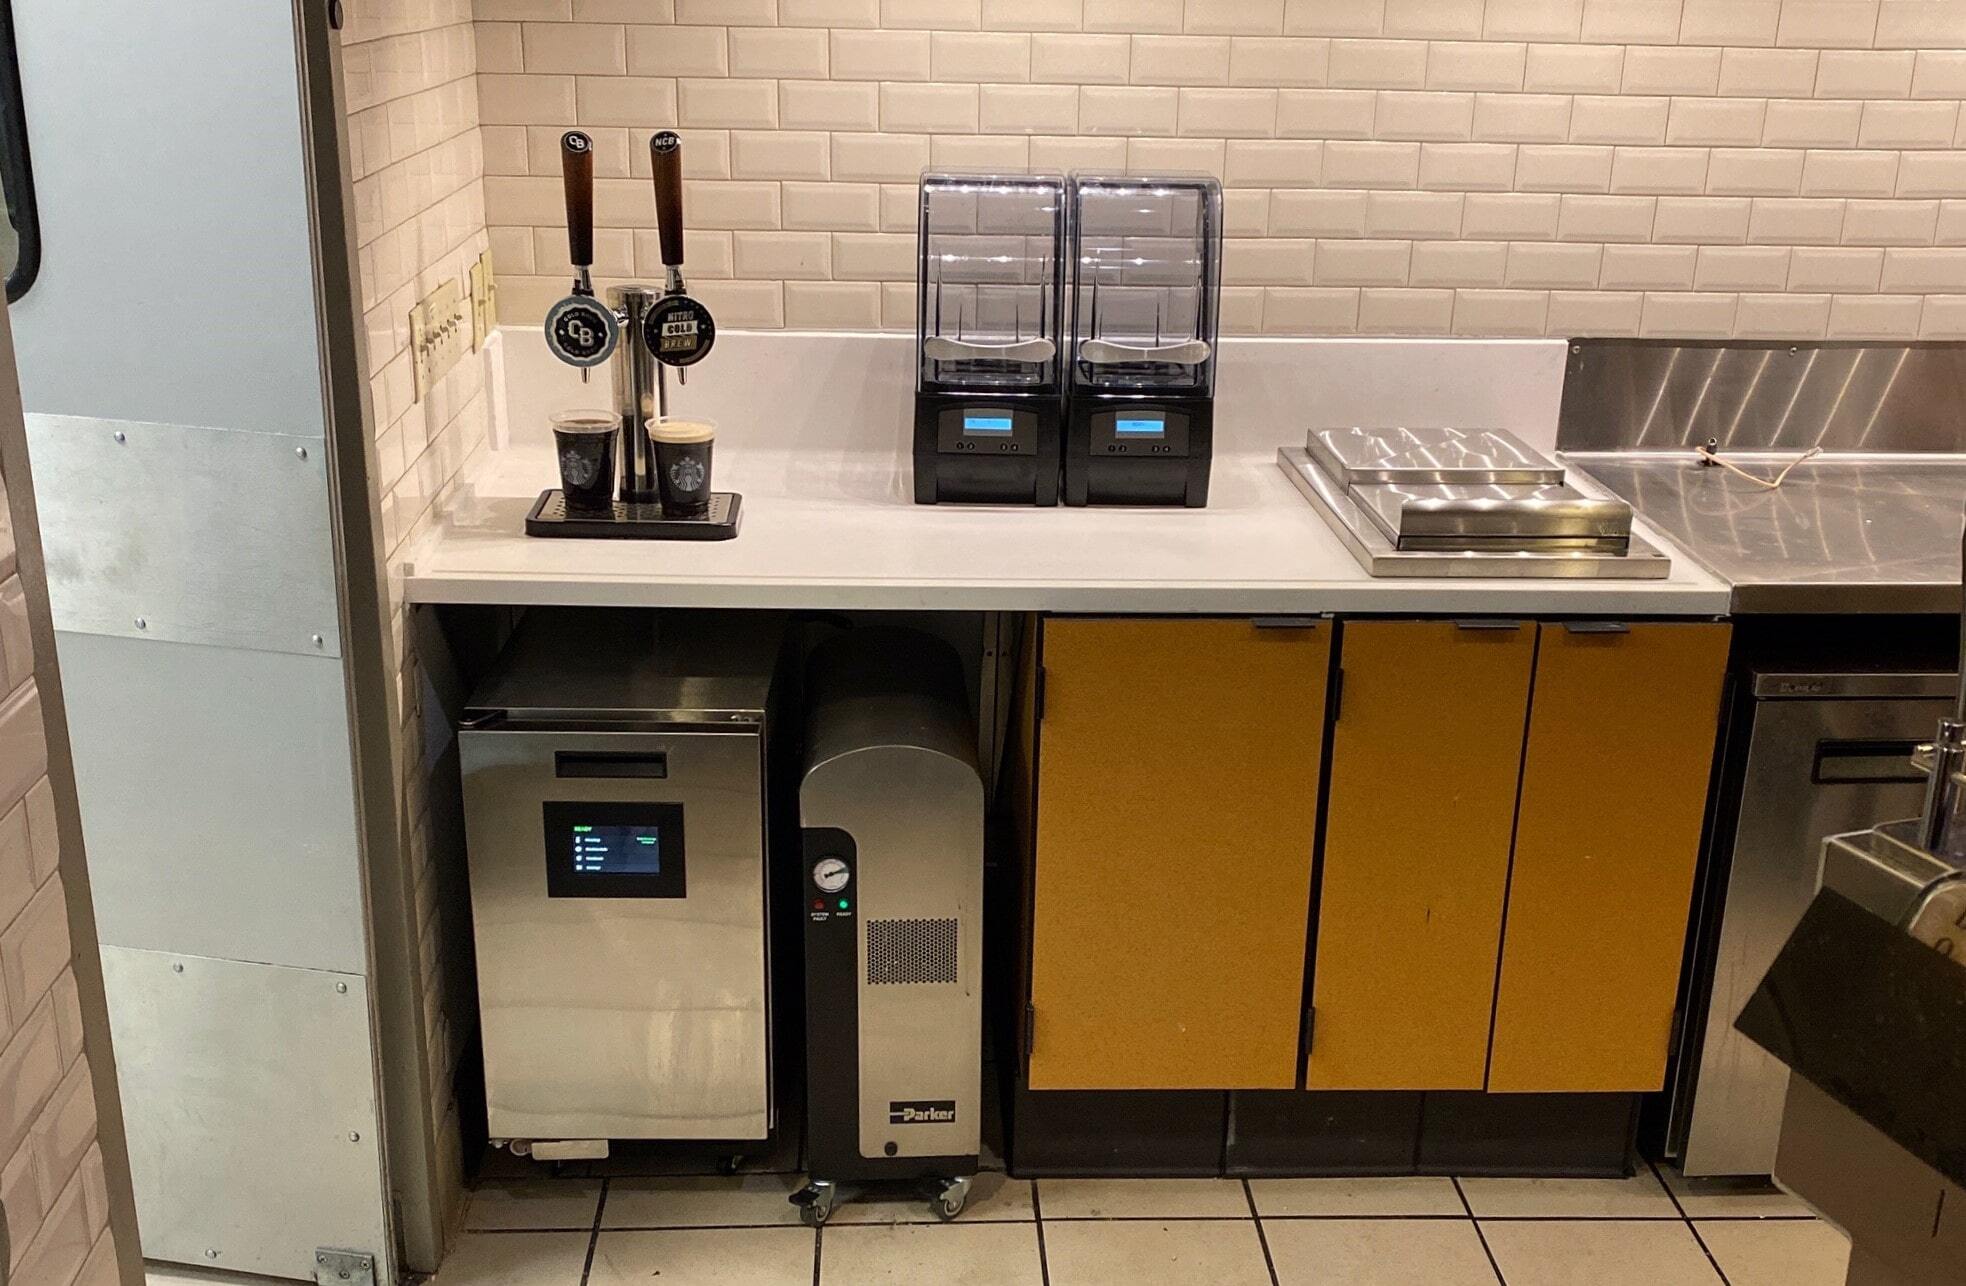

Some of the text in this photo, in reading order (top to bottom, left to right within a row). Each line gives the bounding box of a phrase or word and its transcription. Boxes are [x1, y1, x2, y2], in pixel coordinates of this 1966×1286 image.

[655, 136, 675, 147] NCB
[667, 310, 694, 321] NITRO
[667, 322, 693, 335] COLD
[903, 1107, 954, 1121] Parker
